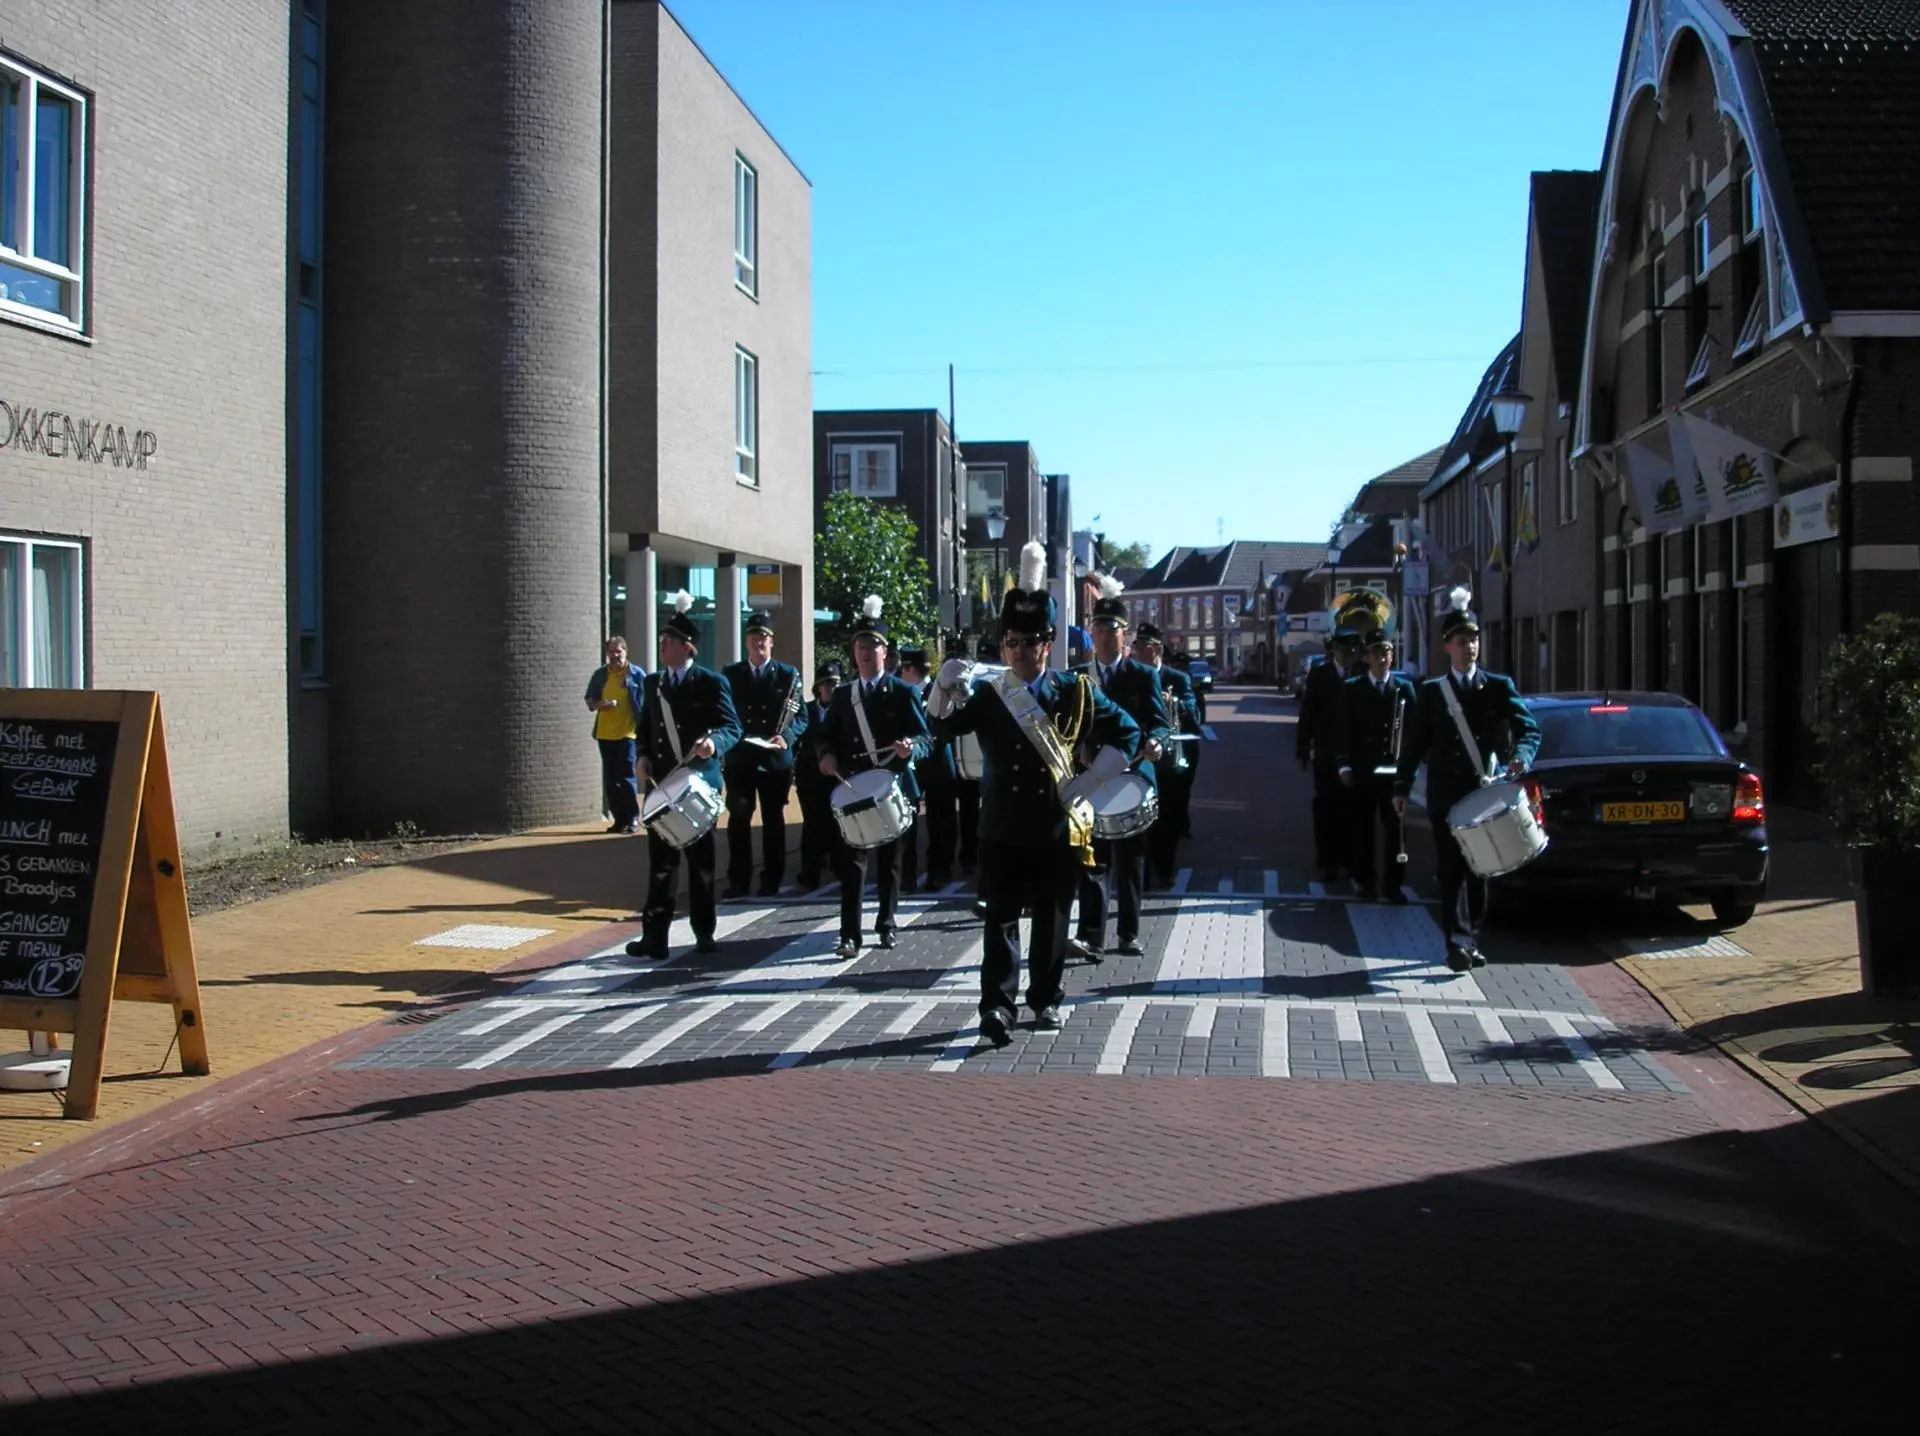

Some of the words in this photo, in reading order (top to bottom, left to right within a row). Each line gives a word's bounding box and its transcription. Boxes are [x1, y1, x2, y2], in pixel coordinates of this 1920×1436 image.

[1607, 803, 1680, 819] XR-DN-30
[17, 856, 91, 875] GEBAKKEN
[3, 875, 77, 905] Broodjes
[0, 911, 71, 933] GANGEN
[17, 940, 62, 957] MENU
